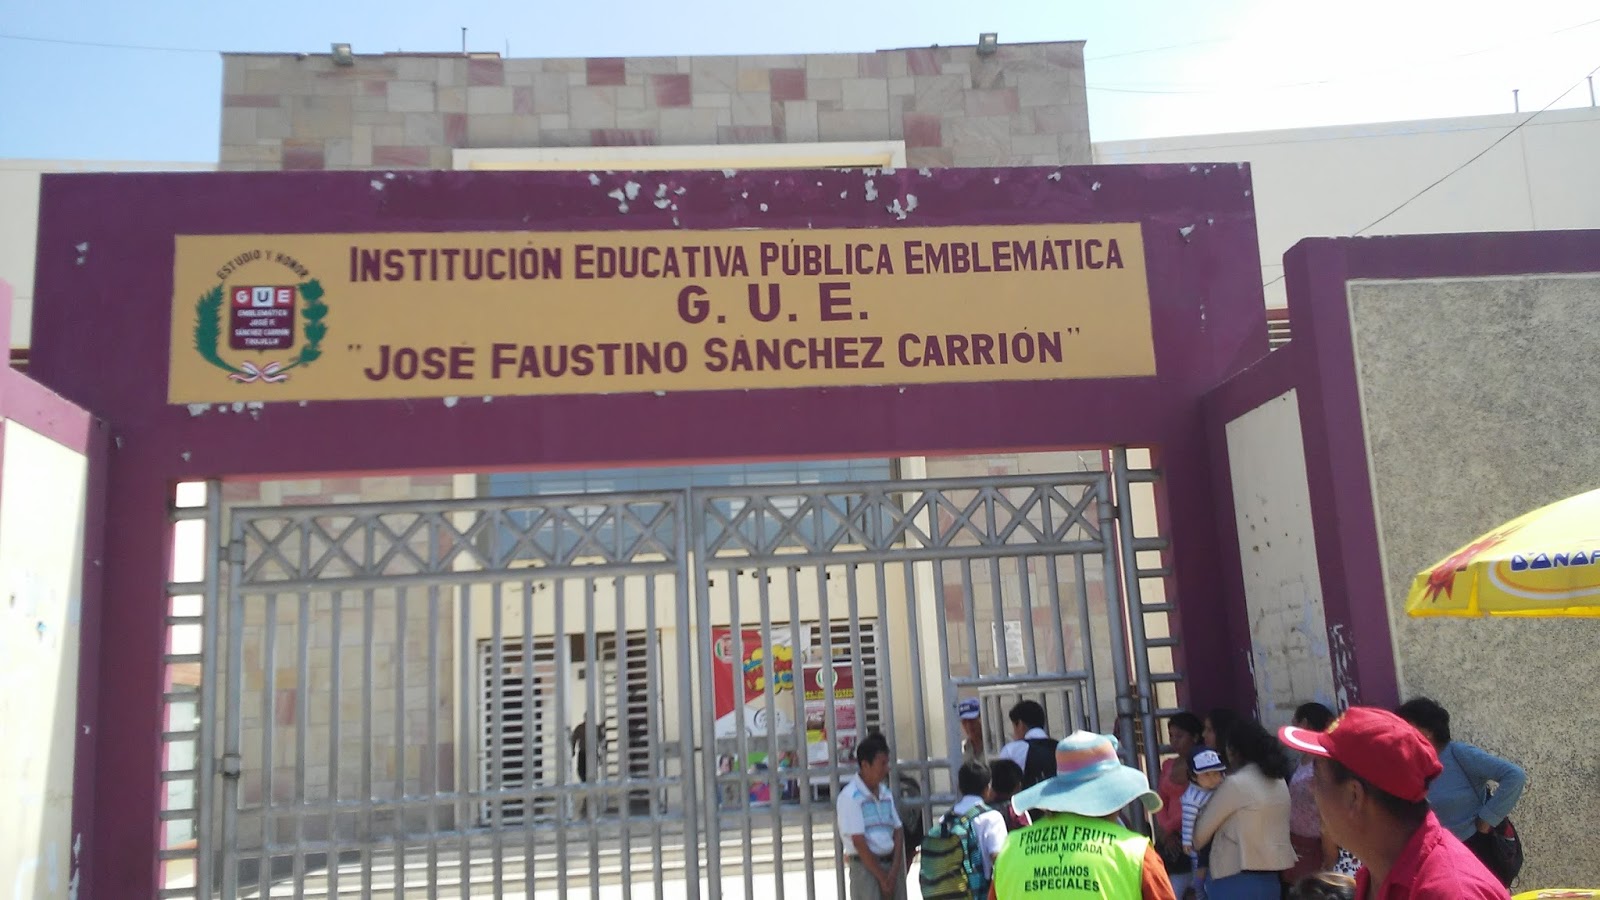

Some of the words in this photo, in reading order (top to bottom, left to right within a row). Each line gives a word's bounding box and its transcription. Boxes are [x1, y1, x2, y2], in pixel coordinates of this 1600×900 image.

[216, 249, 262, 280] ESTUDIO
[264, 250, 272, 260] Y
[574, 244, 749, 280] EDUCATIVA
[760, 238, 894, 276] PÚBLICA
[904, 235, 1124, 275] EMBLEMÁTICA
[491, 341, 687, 379] FAUSTINO
[704, 335, 884, 372] SÁNCHEZ
[1019, 826, 1069, 848] FROZEN
[1072, 826, 1117, 847] FRUIT
[1024, 842, 1059, 856] CHICHA
[1061, 842, 1103, 856] MORADA
[1057, 853, 1065, 864] Y
[1033, 864, 1089, 878] MARCIANOS
[1024, 878, 1100, 893] ESPECIALES
